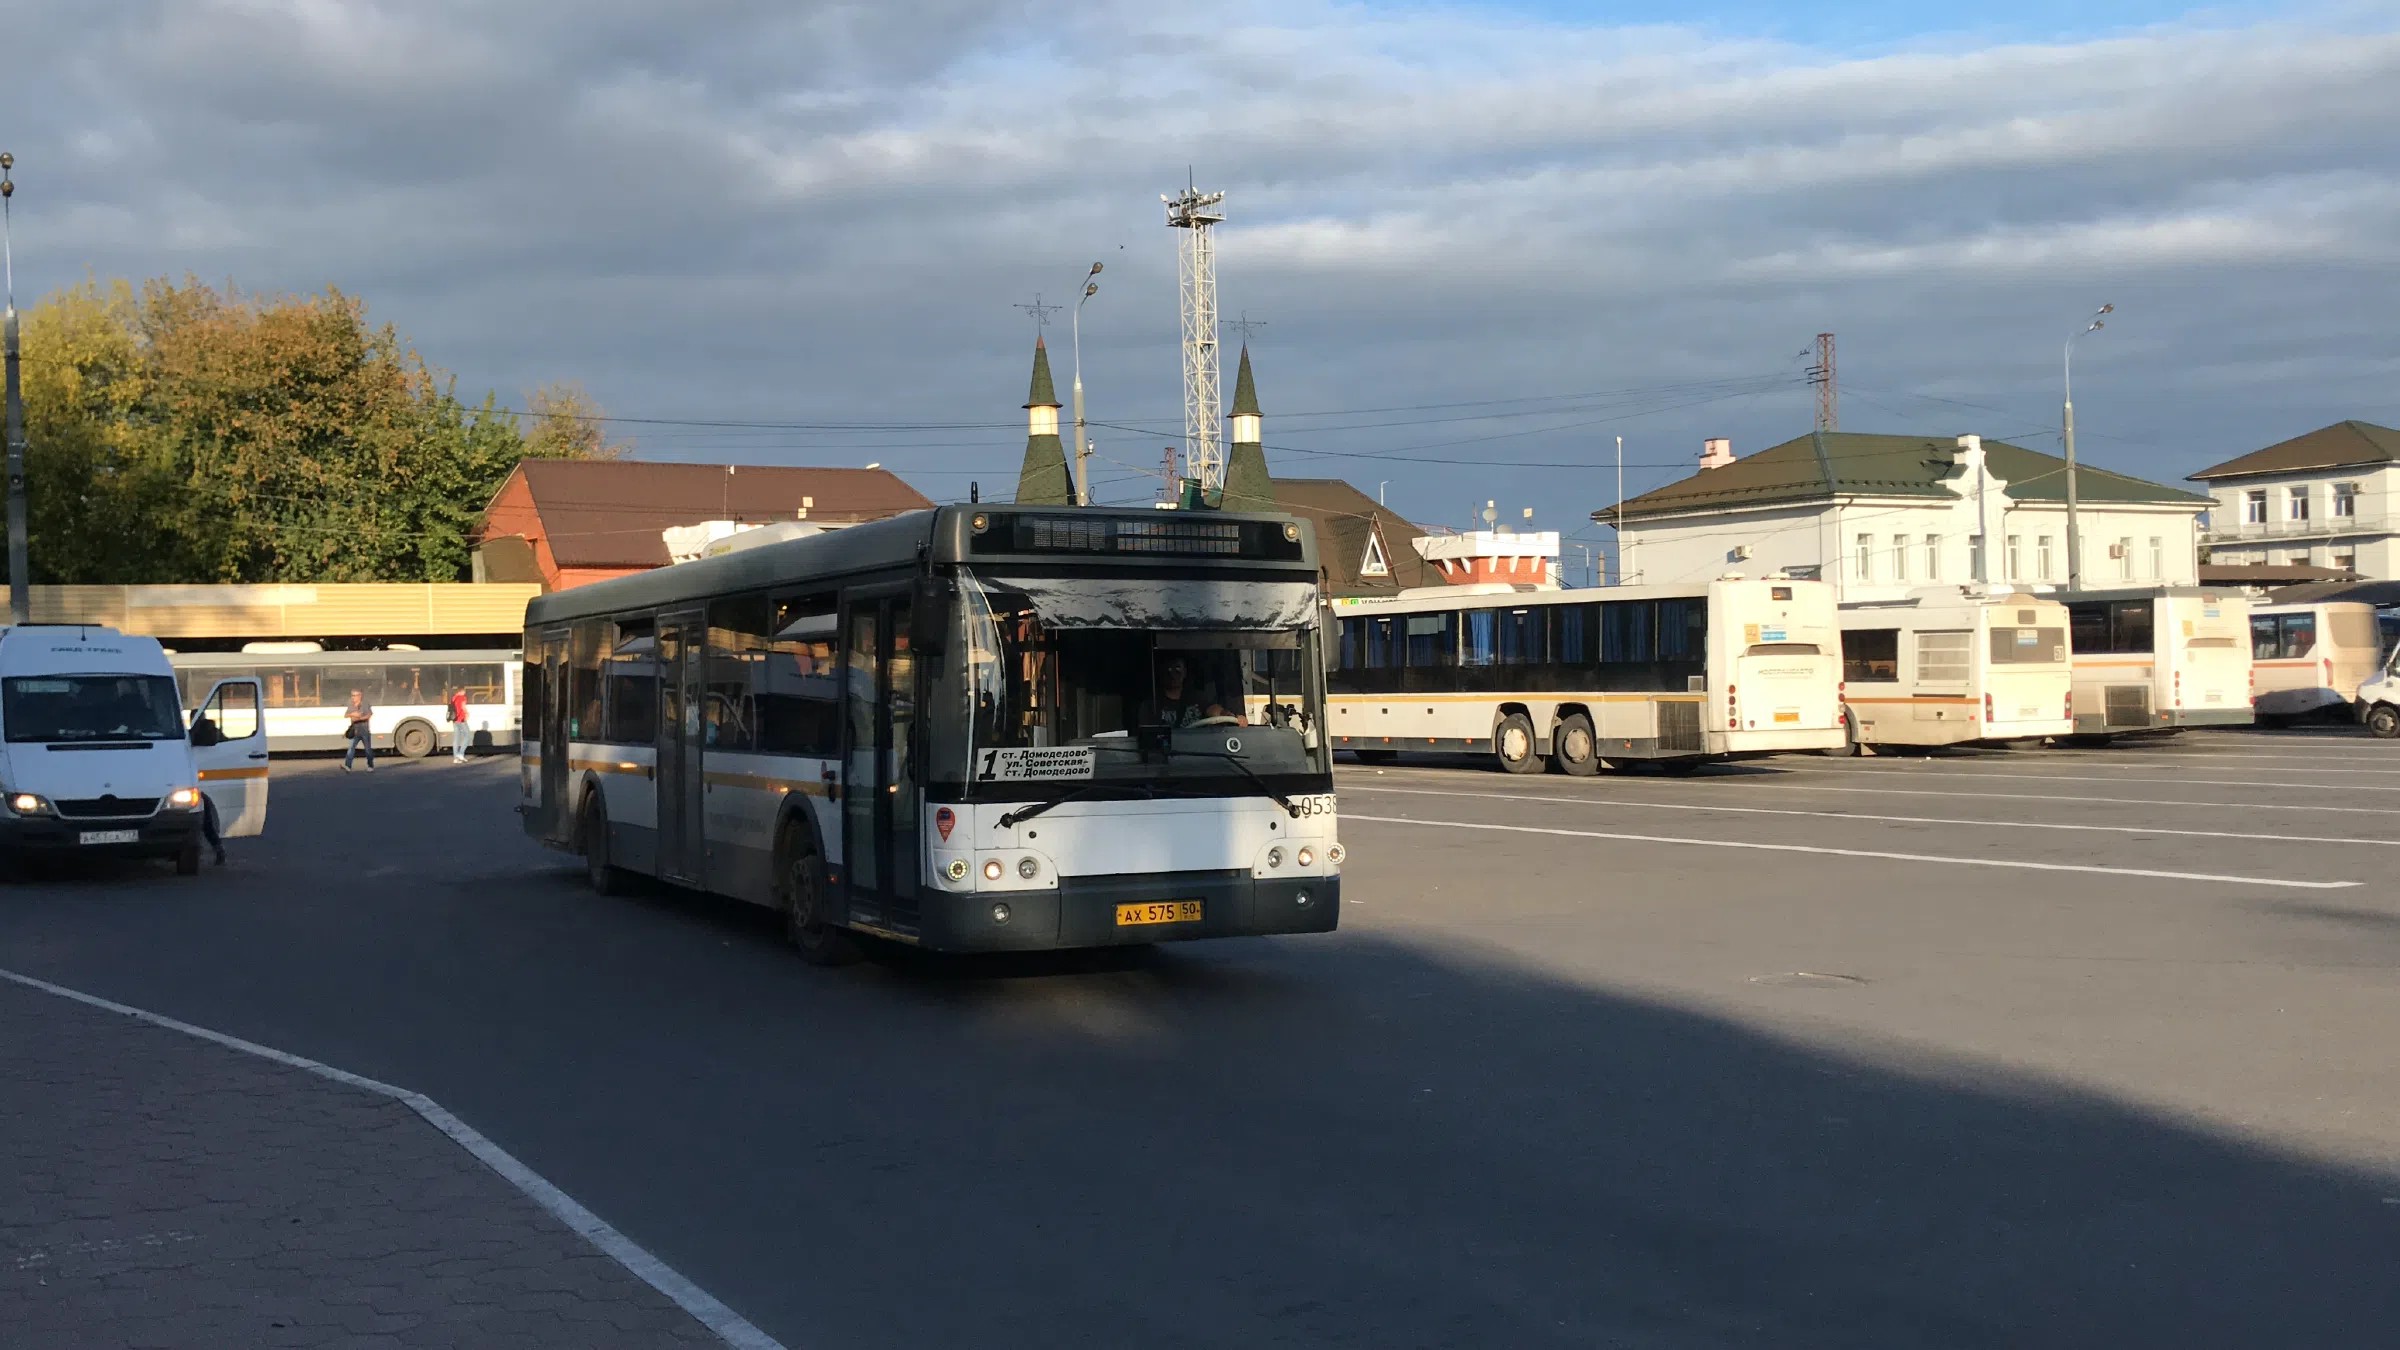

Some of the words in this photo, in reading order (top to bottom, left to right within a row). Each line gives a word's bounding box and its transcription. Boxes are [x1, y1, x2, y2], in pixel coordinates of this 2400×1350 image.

[1001, 751, 1018, 759] ст.
[978, 750, 998, 780] 1
[1006, 760, 1023, 769] ул.
[1005, 769, 1021, 777] ст.
[1023, 767, 1090, 778] Домодедово
[1148, 904, 1175, 921] 575
[1182, 902, 1196, 915] 50
